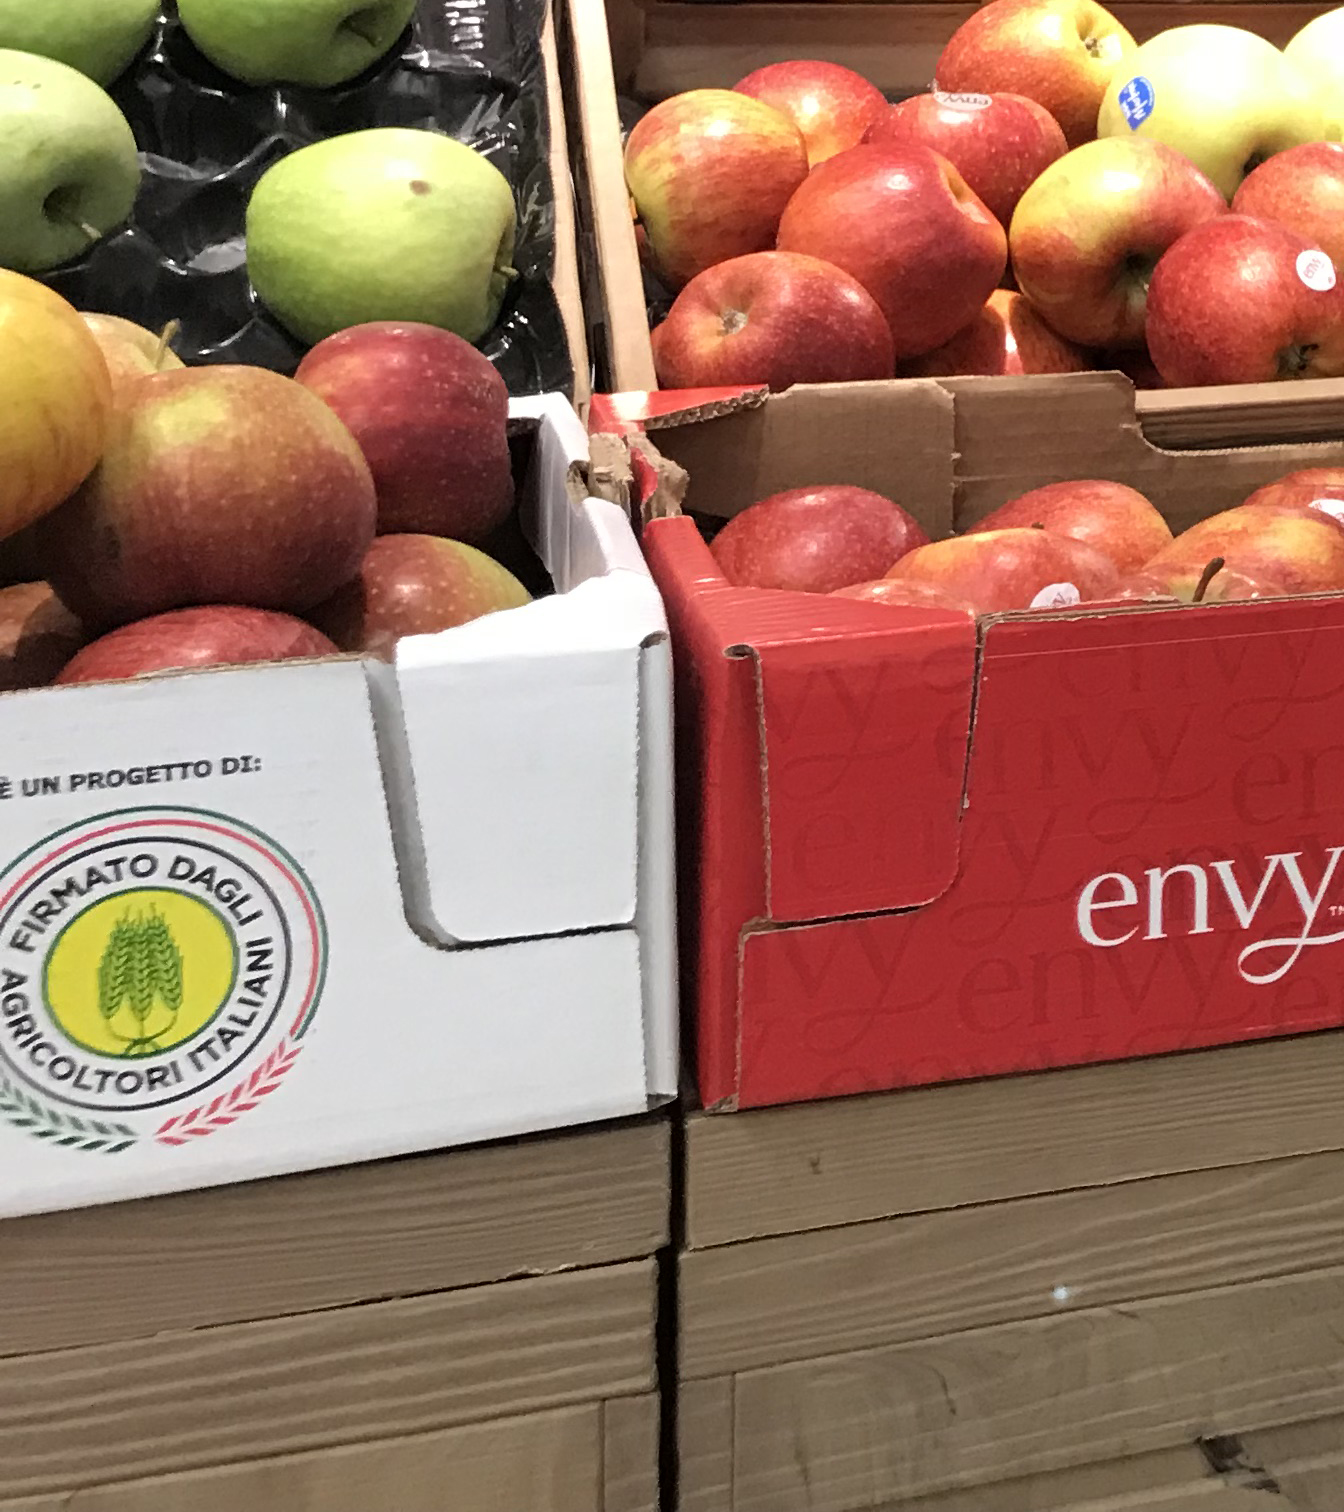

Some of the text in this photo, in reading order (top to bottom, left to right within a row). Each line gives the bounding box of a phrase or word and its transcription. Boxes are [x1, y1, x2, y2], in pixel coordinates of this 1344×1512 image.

[22, 775, 61, 798] UN
[70, 759, 212, 790] PROGETTO
[222, 755, 262, 776] DI:
[9, 853, 264, 953] FIRMATO DAGLI
[1, 937, 273, 1095] AGRICOLTORI ITALIANI
